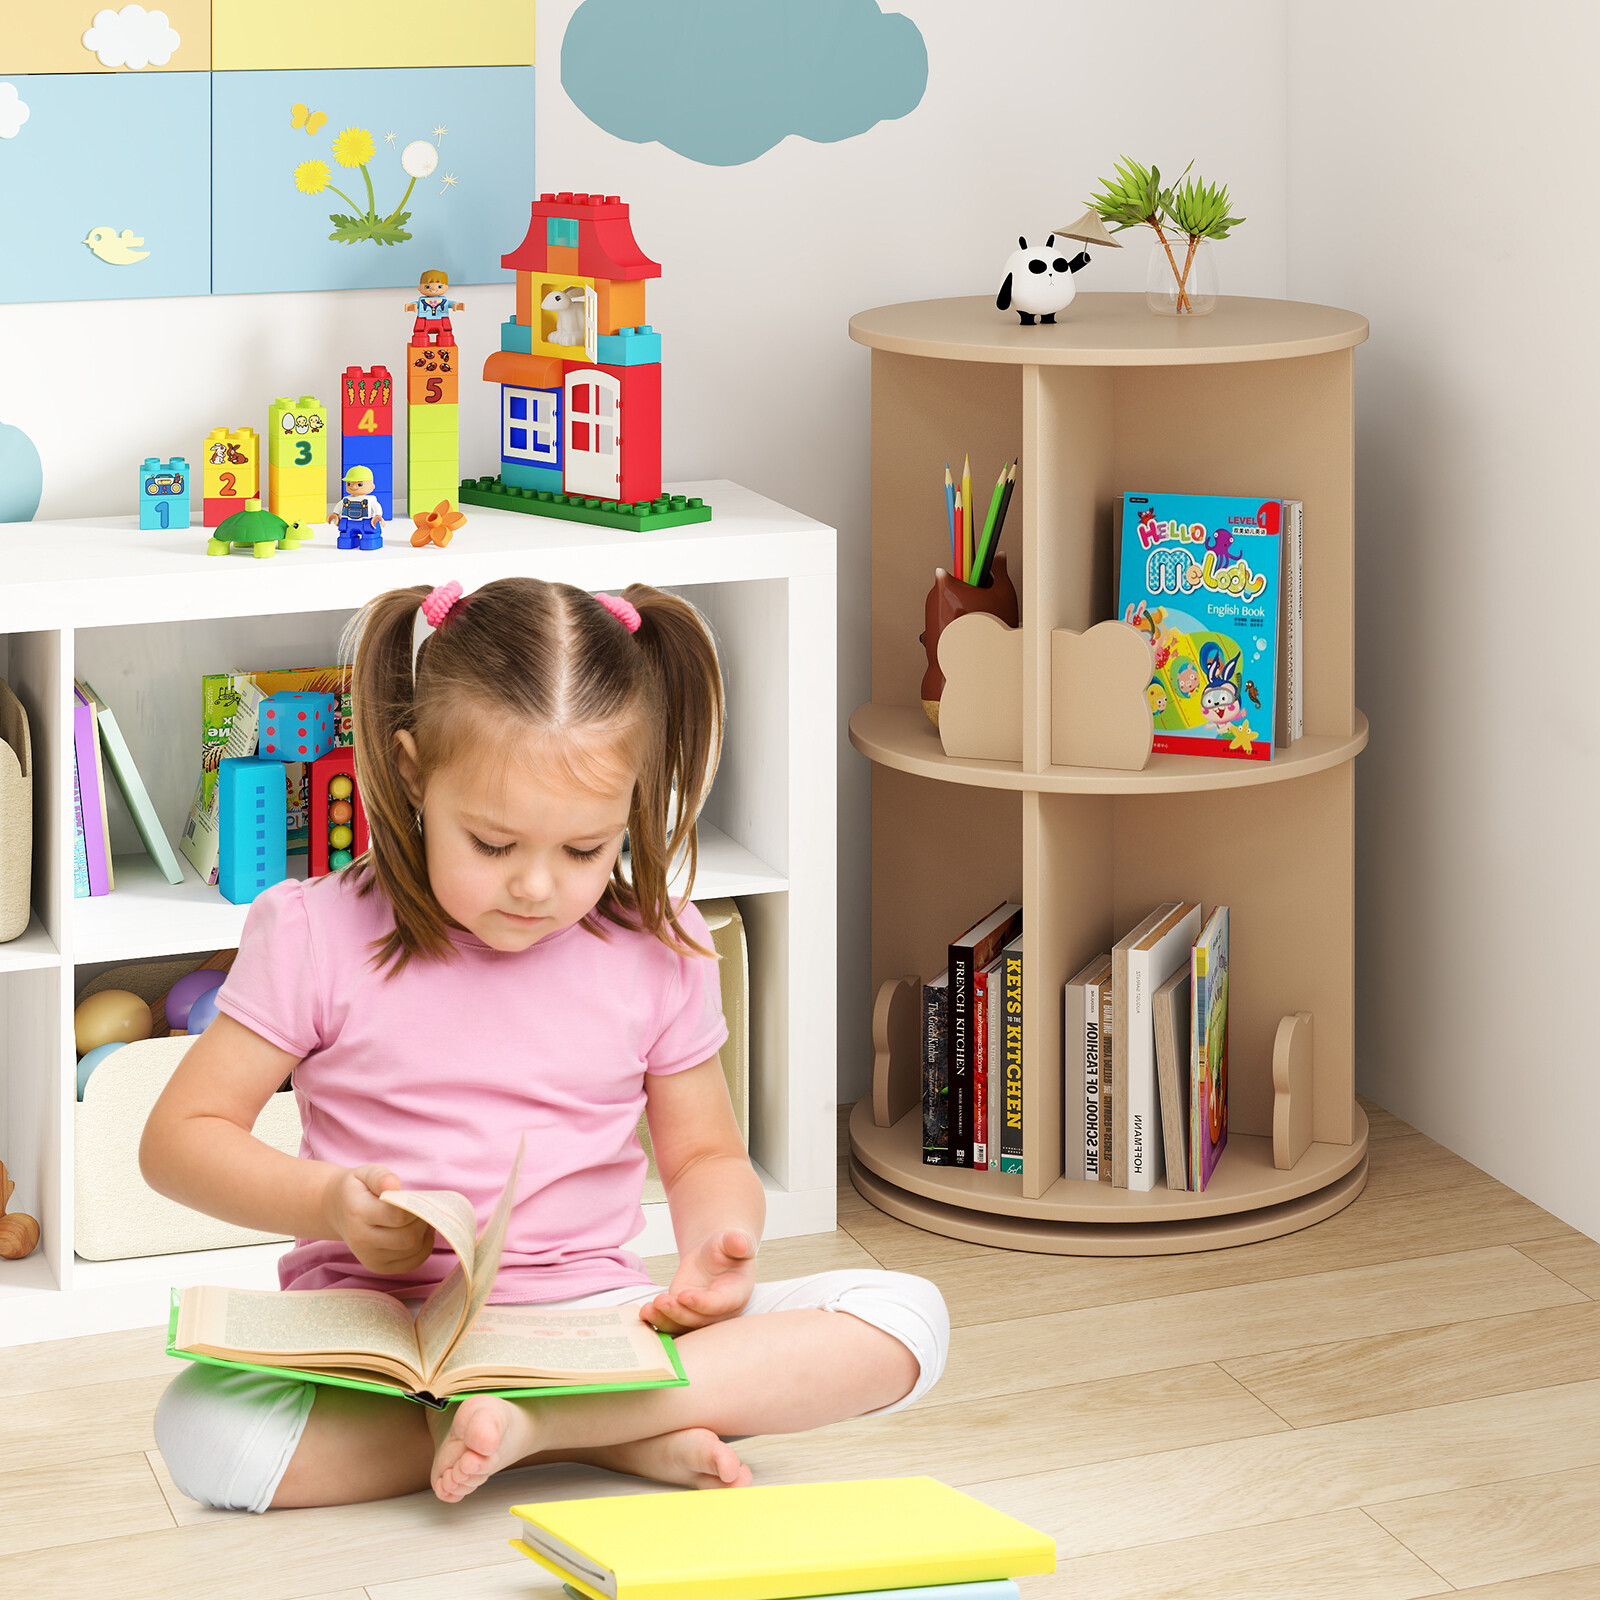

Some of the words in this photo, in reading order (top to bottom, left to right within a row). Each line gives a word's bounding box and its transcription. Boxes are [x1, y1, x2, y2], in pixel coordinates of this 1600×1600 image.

[424, 377, 443, 403] 5
[357, 408, 378, 433] 4
[294, 440, 312, 466] 3
[219, 472, 236, 496] 2
[154, 501, 169, 528] 1
[1228, 516, 1257, 525] LEVEL
[1260, 512, 1267, 526] 1
[1138, 520, 1205, 549] HELLO
[1207, 604, 1240, 618] English
[1242, 606, 1265, 617] Book
[956, 960, 965, 1013] FRENCH
[1006, 958, 1022, 1014] KEYS
[928, 1002, 940, 1014] The
[928, 1016, 939, 1037] Green
[928, 1038, 940, 1063] Kitchen
[956, 1018, 965, 1076] KITCHEN
[1006, 1024, 1022, 1130] KITCHEN
